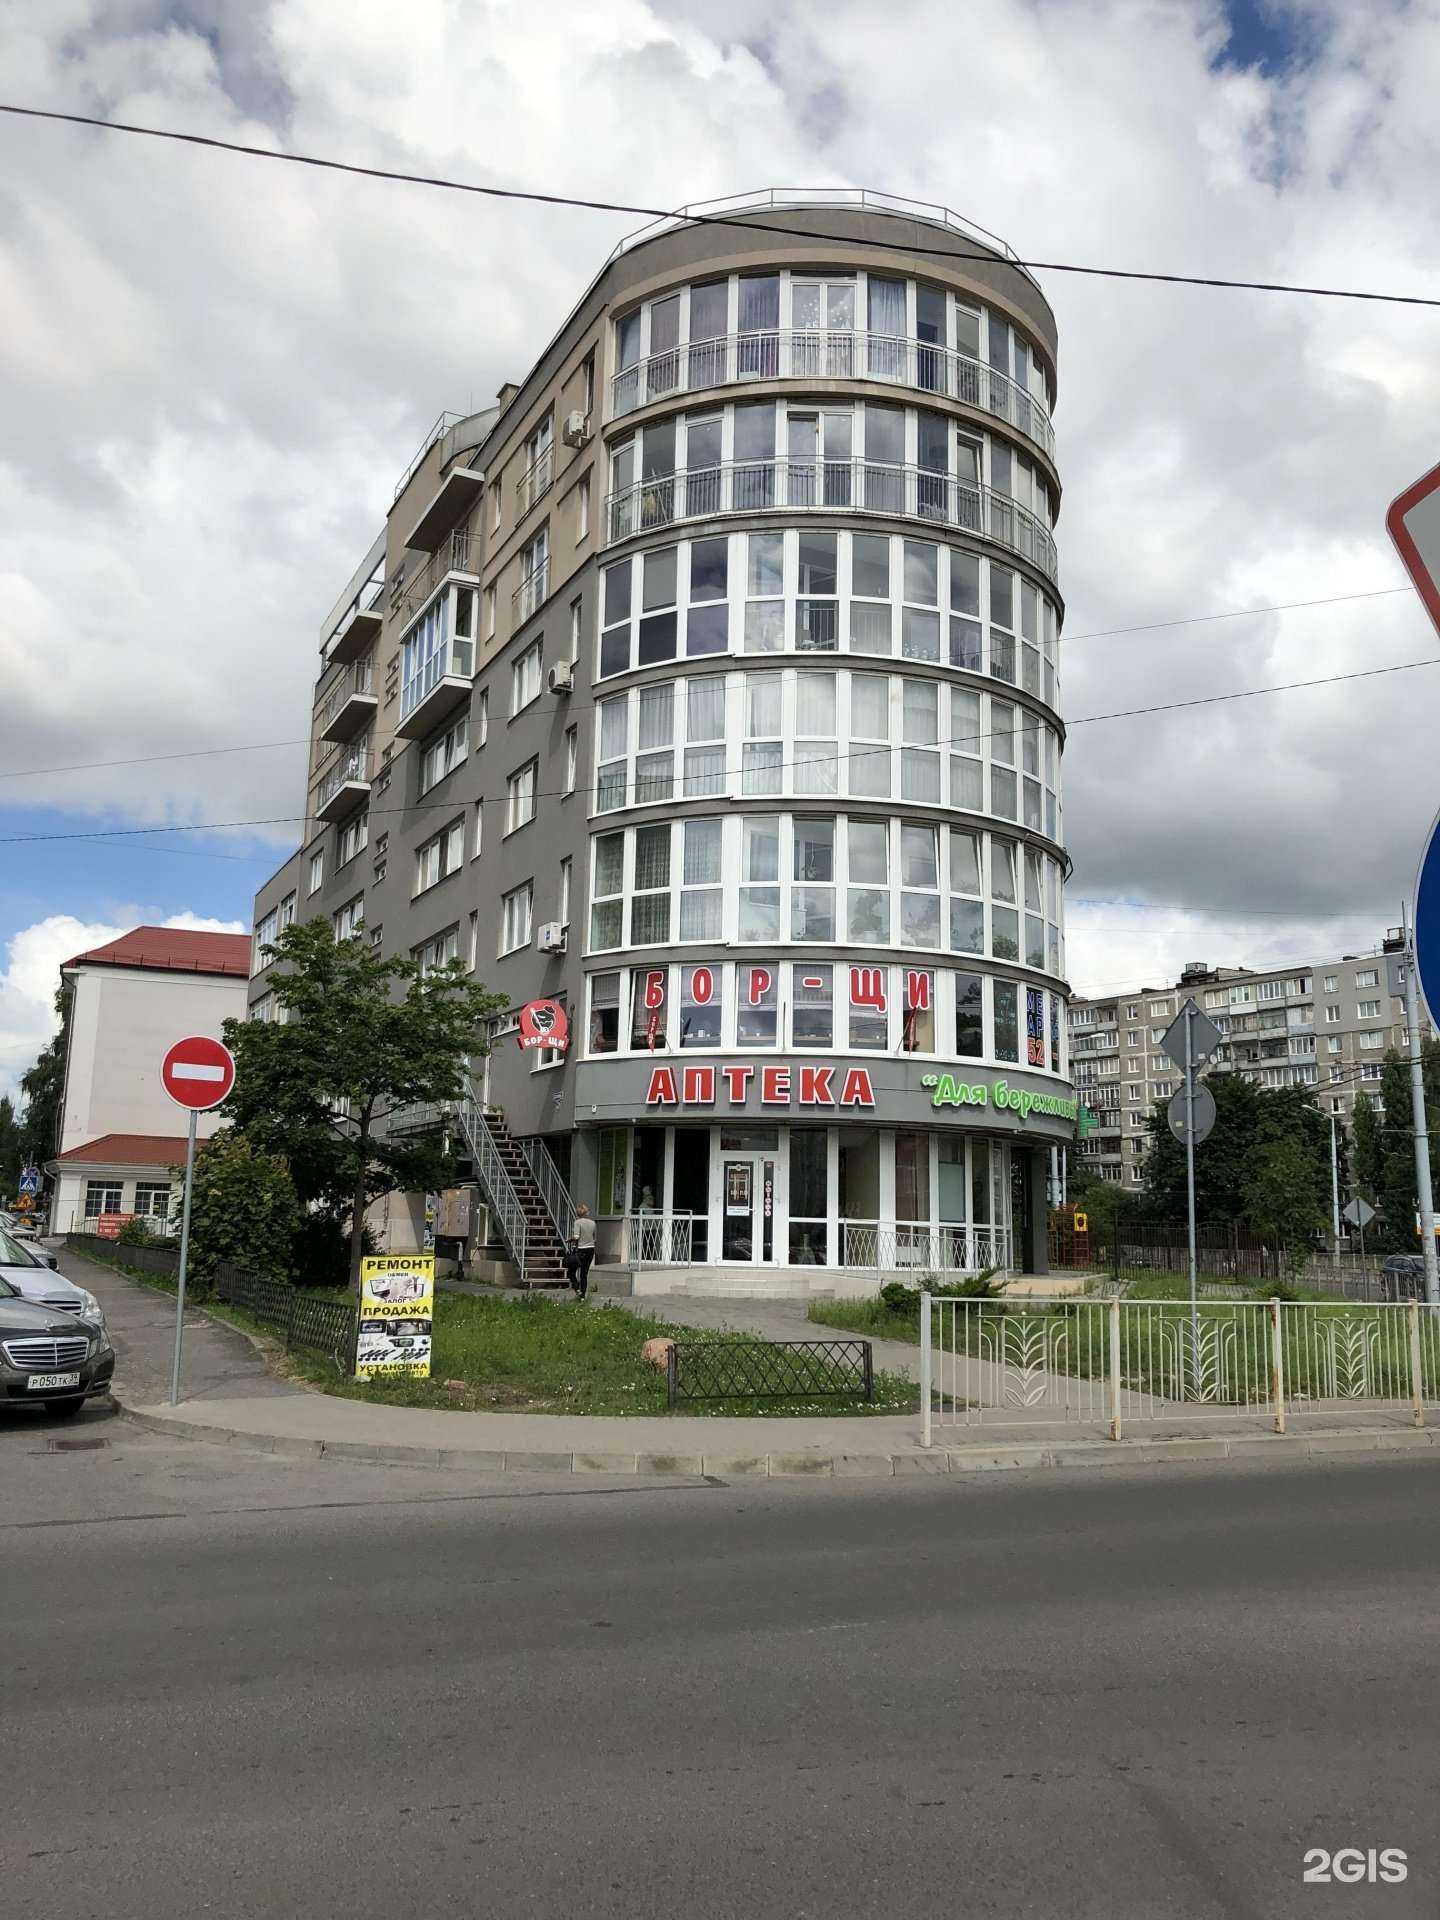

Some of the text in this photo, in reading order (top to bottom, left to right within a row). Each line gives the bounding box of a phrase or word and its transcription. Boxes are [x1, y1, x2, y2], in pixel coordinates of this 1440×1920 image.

[644, 966, 931, 1013] БОР-ЩИ
[523, 1036, 566, 1048] БОР-ЩИ
[646, 1066, 877, 1106] АПТЕКА
[366, 1259, 432, 1270] РЕМОНТ
[363, 1305, 430, 1316] ПРОДАЖА
[359, 1362, 428, 1372] УСТАНОВКА
